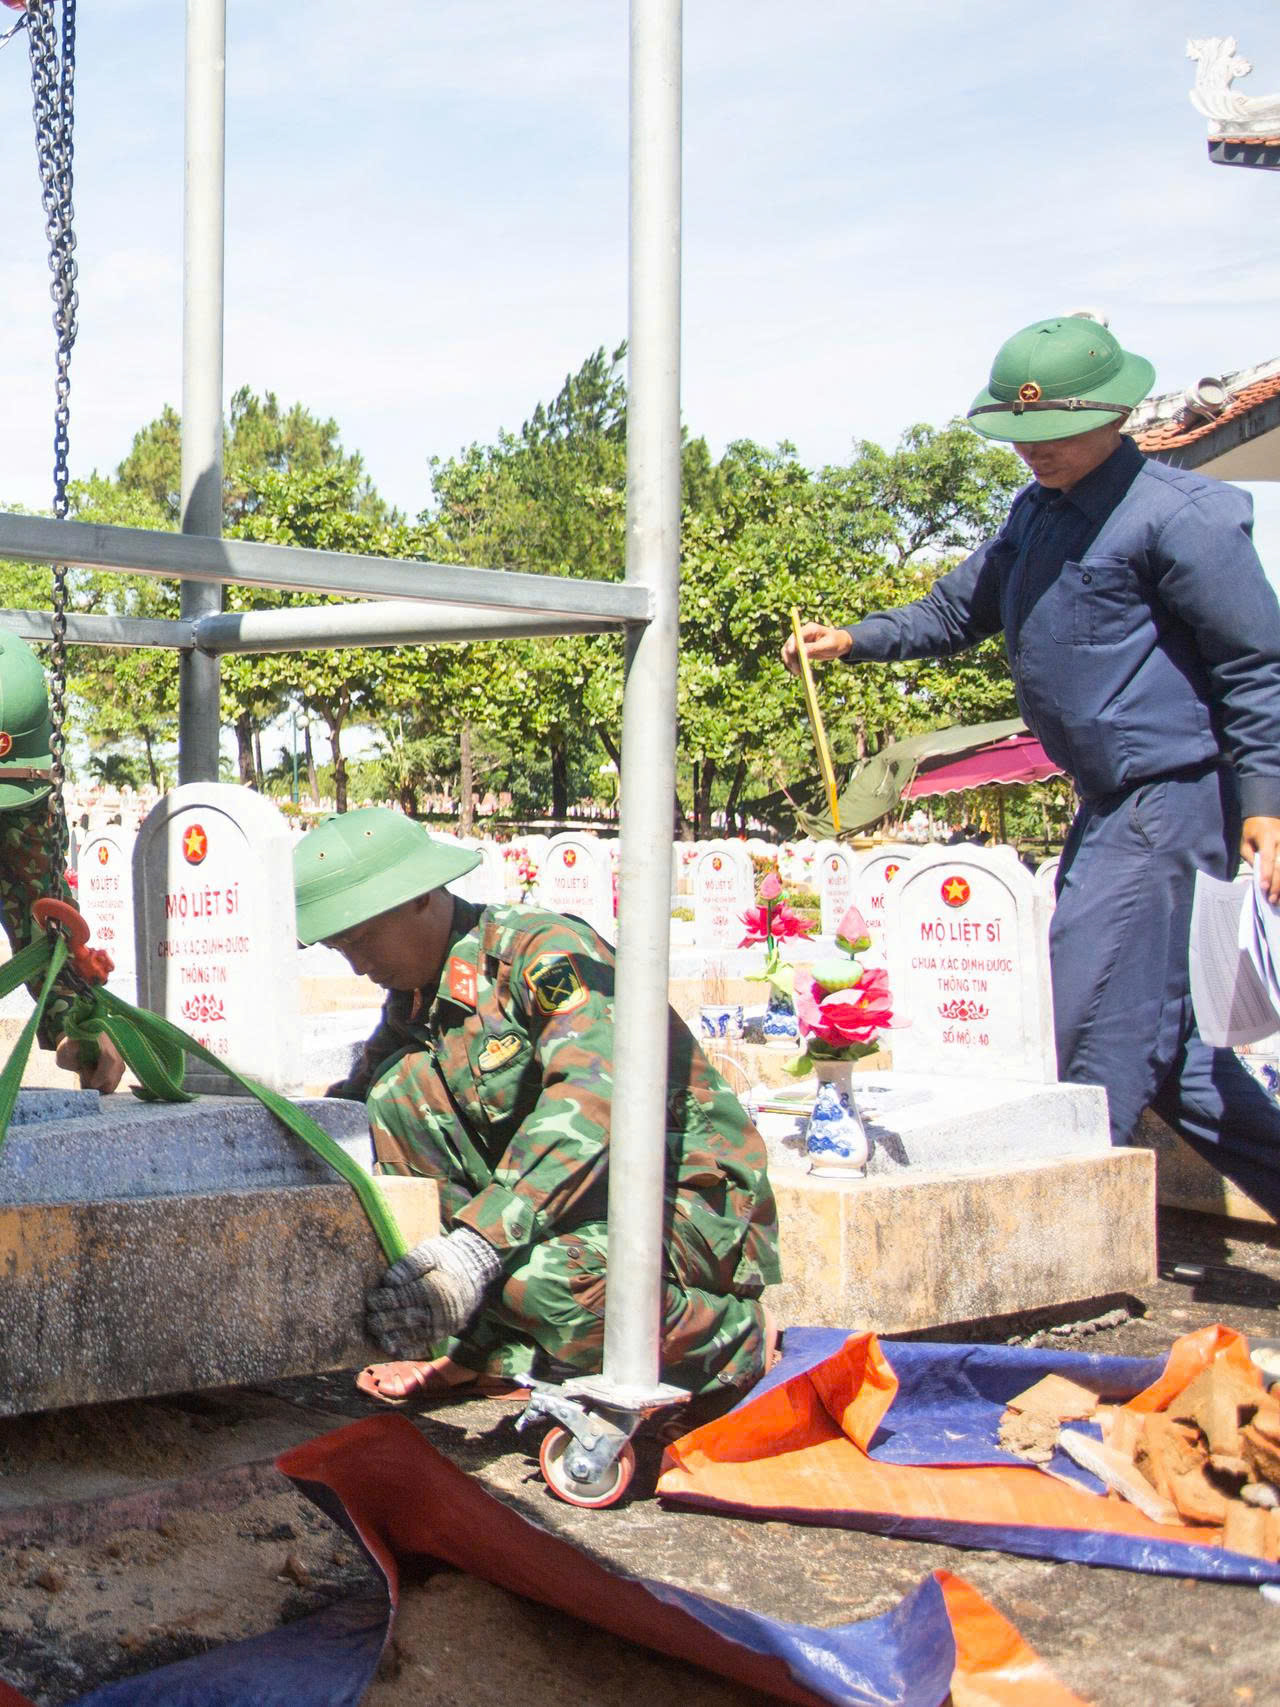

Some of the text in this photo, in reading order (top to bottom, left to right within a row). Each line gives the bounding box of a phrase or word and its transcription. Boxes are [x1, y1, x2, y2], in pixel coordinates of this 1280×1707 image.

[165, 886, 188, 926] MỘ
[191, 884, 221, 923] LIỆT
[921, 917, 1001, 947] MỘ LIỆT SĨ
[212, 966, 226, 983] TIN
[938, 975, 987, 993] THÔNG TIN
[942, 1025, 955, 1043] SỐ
